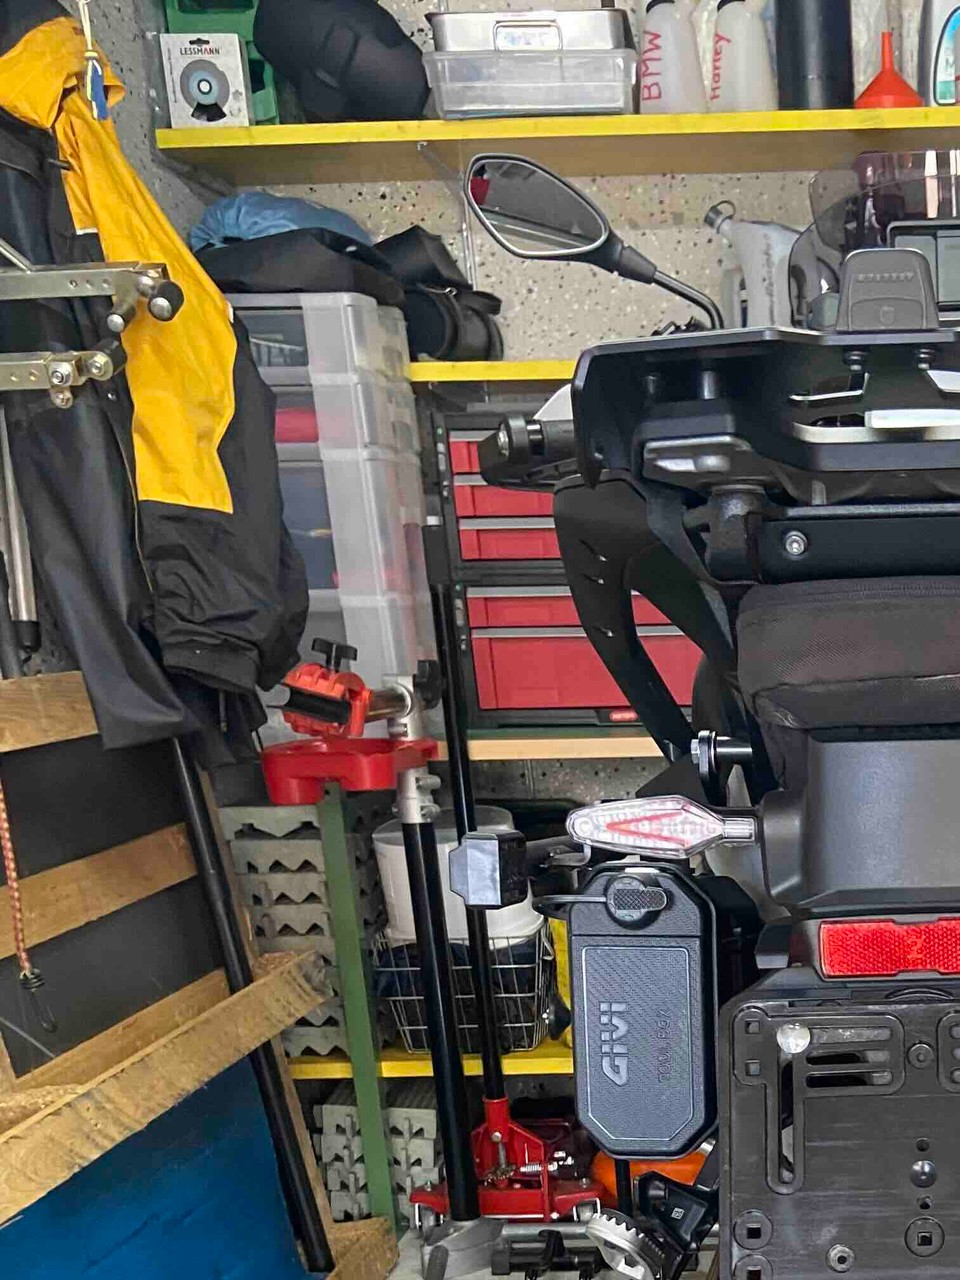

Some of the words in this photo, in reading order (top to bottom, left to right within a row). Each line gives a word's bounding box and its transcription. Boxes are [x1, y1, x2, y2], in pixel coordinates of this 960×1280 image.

[180, 46, 220, 56] LESSMANN
[642, 30, 662, 100] BMW
[710, 29, 731, 100] Harley
[600, 1001, 628, 1087] GIVI
